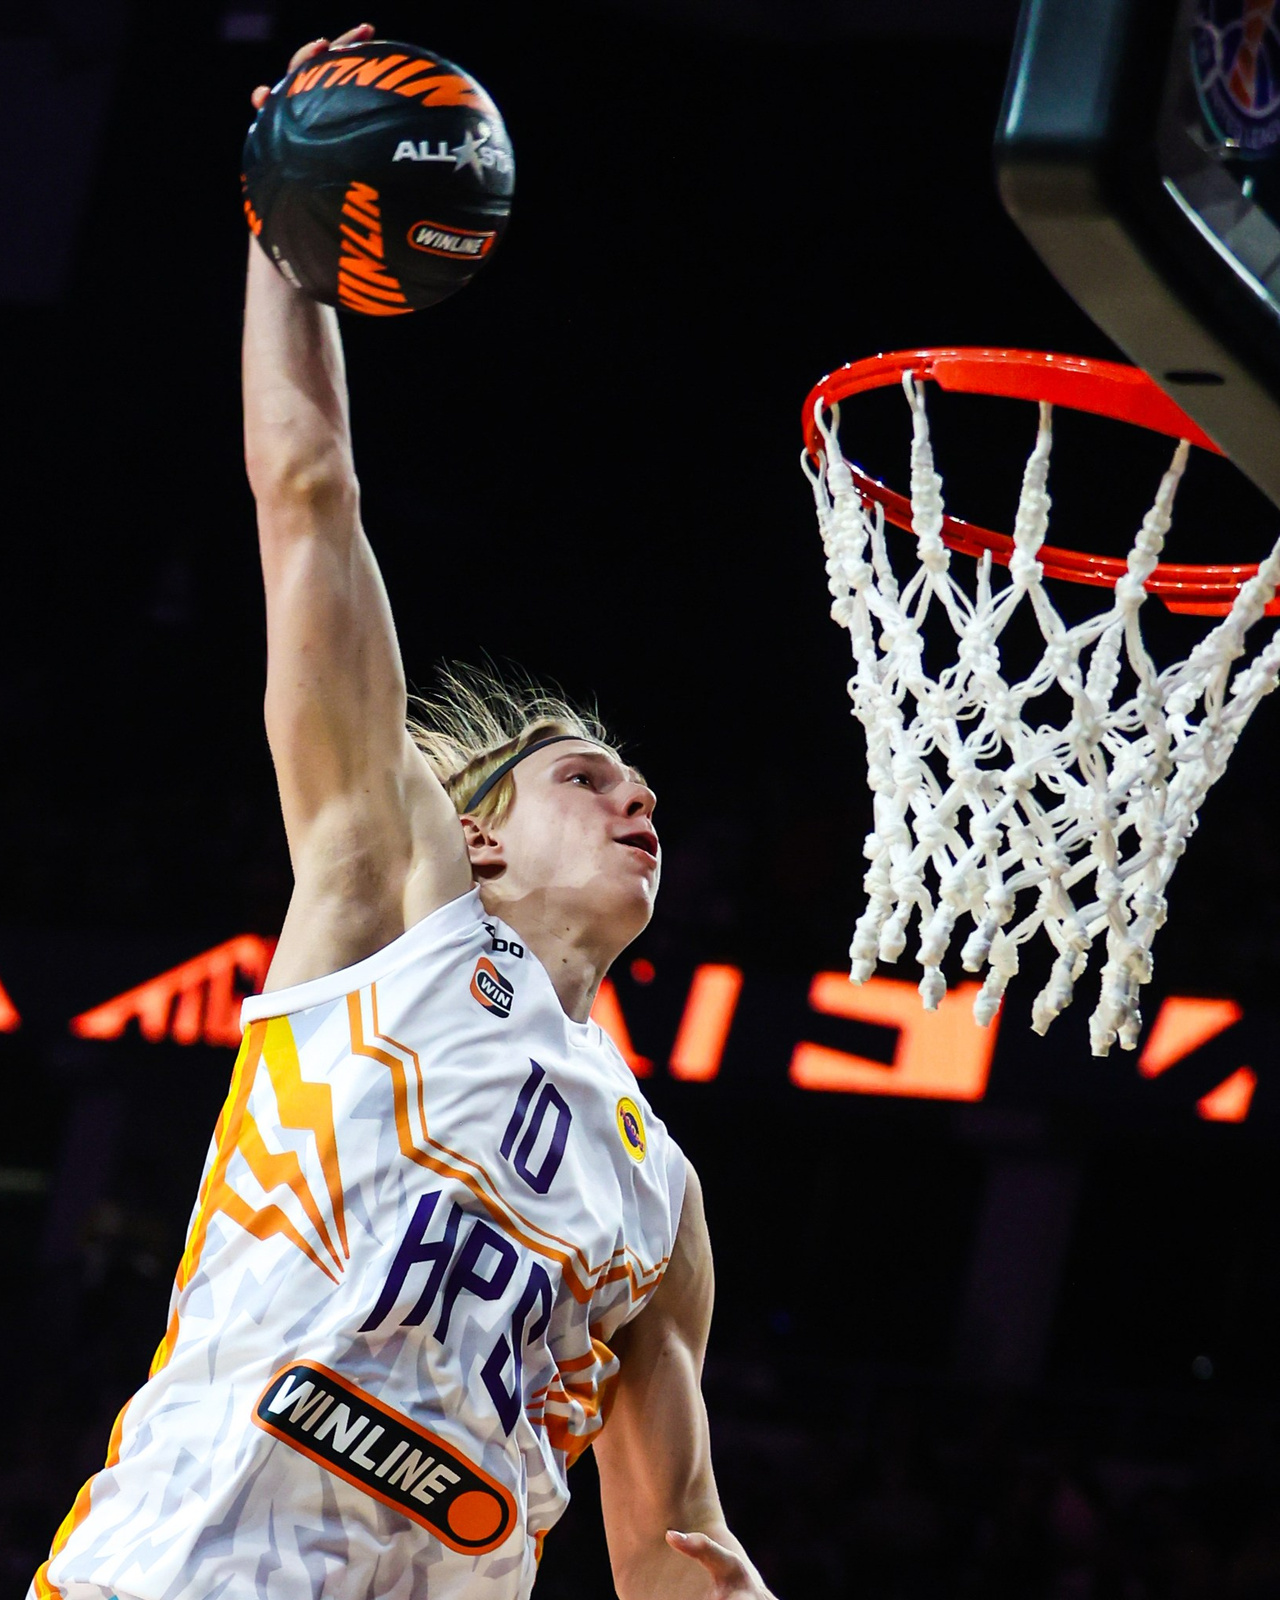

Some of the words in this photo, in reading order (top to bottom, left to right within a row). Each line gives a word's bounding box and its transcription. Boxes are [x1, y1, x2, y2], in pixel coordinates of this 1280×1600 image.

[415, 227, 486, 255] WINLINE
[480, 976, 511, 1007] WIN
[500, 1057, 572, 1194] 10
[269, 1374, 462, 1506] WINLINE
